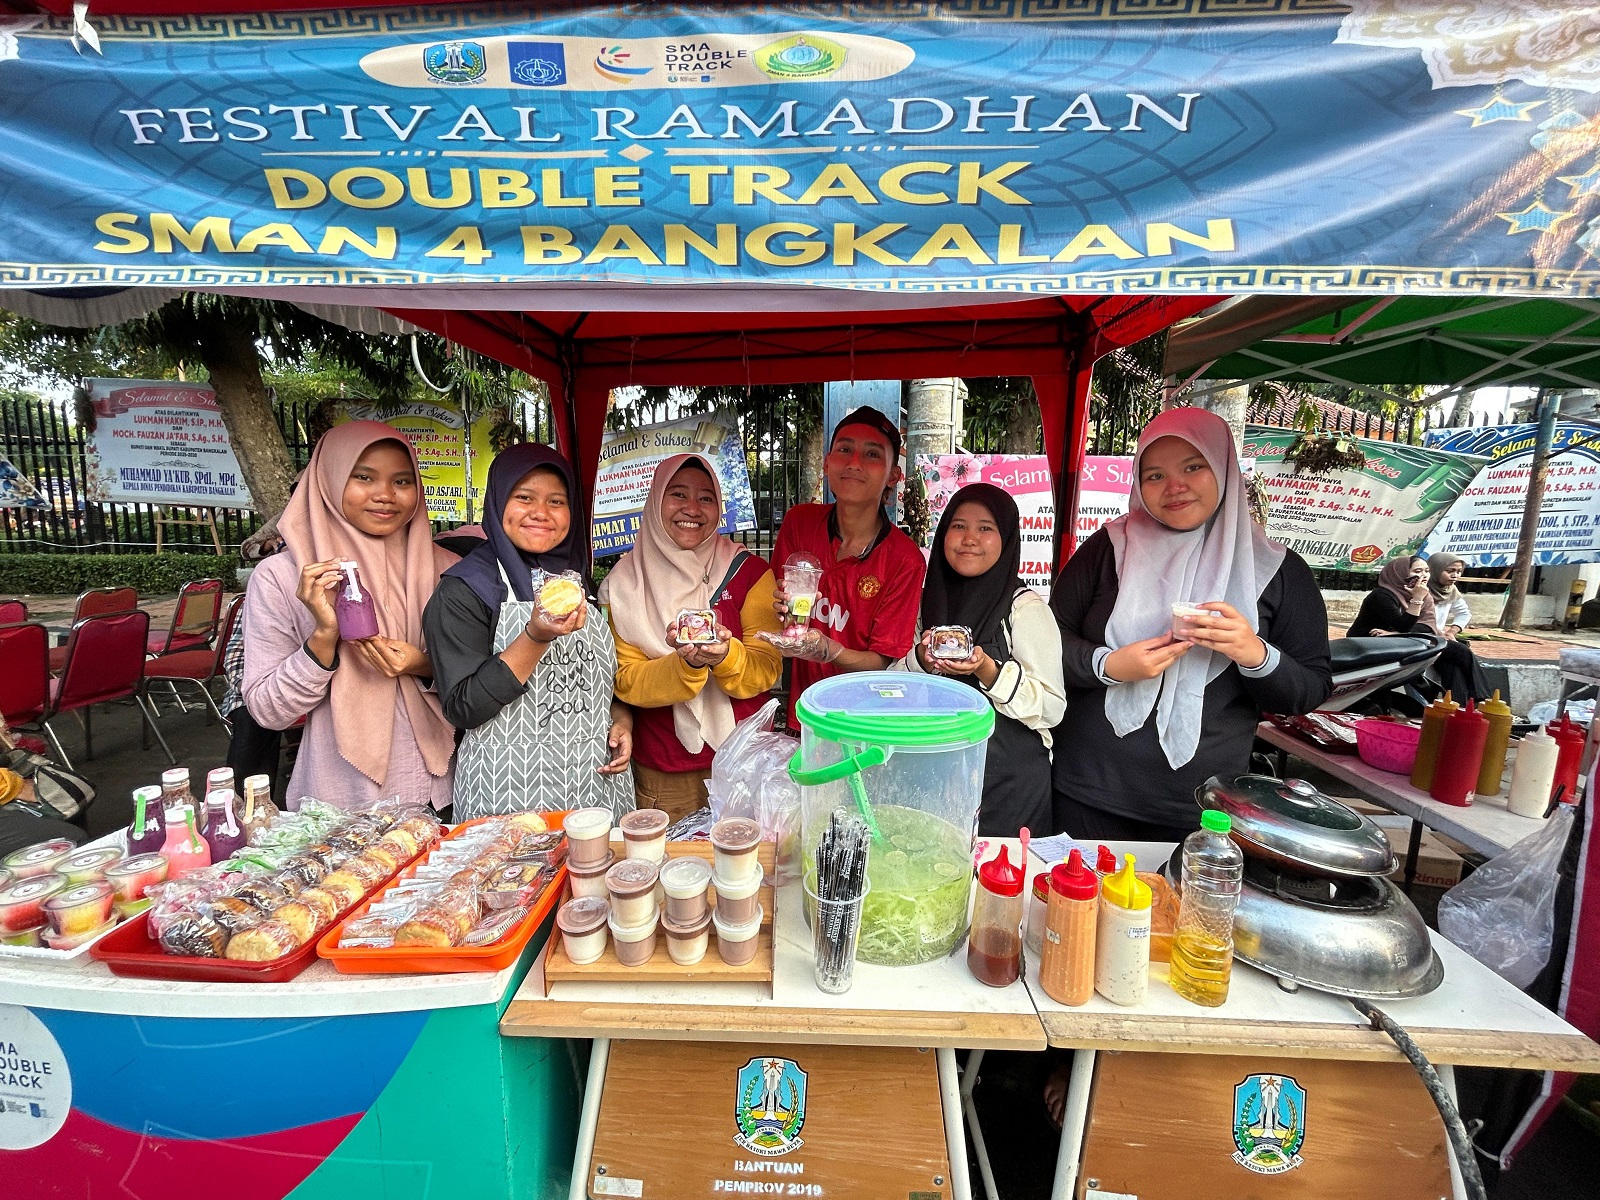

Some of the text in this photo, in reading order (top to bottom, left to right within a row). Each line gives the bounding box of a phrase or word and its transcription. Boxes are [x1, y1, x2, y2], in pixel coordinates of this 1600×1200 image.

[665, 42, 711, 53] SMA
[666, 50, 747, 62] DOUBLE
[664, 60, 733, 72] TRACK
[119, 92, 1200, 145] FESTIVAL RAMADHAN
[264, 160, 1036, 210] DOUBLE TRACK
[93, 212, 1238, 268] SMAN 4 BANGKALAN
[118, 390, 170, 406] Selamat
[174, 390, 188, 403] &
[414, 402, 424, 415] &
[426, 406, 455, 424] Sukses
[133, 415, 164, 425] LUKMAN
[164, 416, 190, 427] HAKIM,
[208, 419, 224, 428] M.H.
[112, 429, 136, 439] MOCH.
[137, 430, 165, 440] FAUZAN
[165, 431, 191, 442] JA'FAR,
[443, 434, 459, 443] M.H.
[641, 434, 650, 448] &
[654, 432, 692, 447] Sukses
[1552, 430, 1566, 444] &
[120, 467, 161, 482] MUHAMMAD
[163, 469, 193, 485] YA'KUB,
[599, 470, 632, 483] LUKMAN
[1293, 474, 1342, 485] DILANTIKNYA
[1487, 469, 1525, 480] LUKMAN
[1578, 466, 1598, 475] M.H.
[122, 482, 236, 496] KEPALA DINAS PENDIDIKAN KABUPATEN BANGKALAN
[605, 482, 635, 495] FAUZAN
[1284, 480, 1320, 493] HAKIM,
[1348, 488, 1371, 499] M.H.
[1487, 485, 1522, 495] FAUZAN
[1281, 496, 1316, 508] JA'FAR,
[1371, 506, 1395, 517] M.H.
[1268, 512, 1289, 520] ERIODE
[1327, 514, 1363, 523] BANGKALAN
[593, 518, 626, 537] HMAT
[1457, 518, 1504, 532] MOHAMMAD
[1292, 538, 1352, 558] BANGKALAN
[546, 671, 591, 694] love
[537, 698, 590, 728] you
[734, 1160, 804, 1175] BANTUAN
[714, 1178, 823, 1196] PEMPROV 2019
